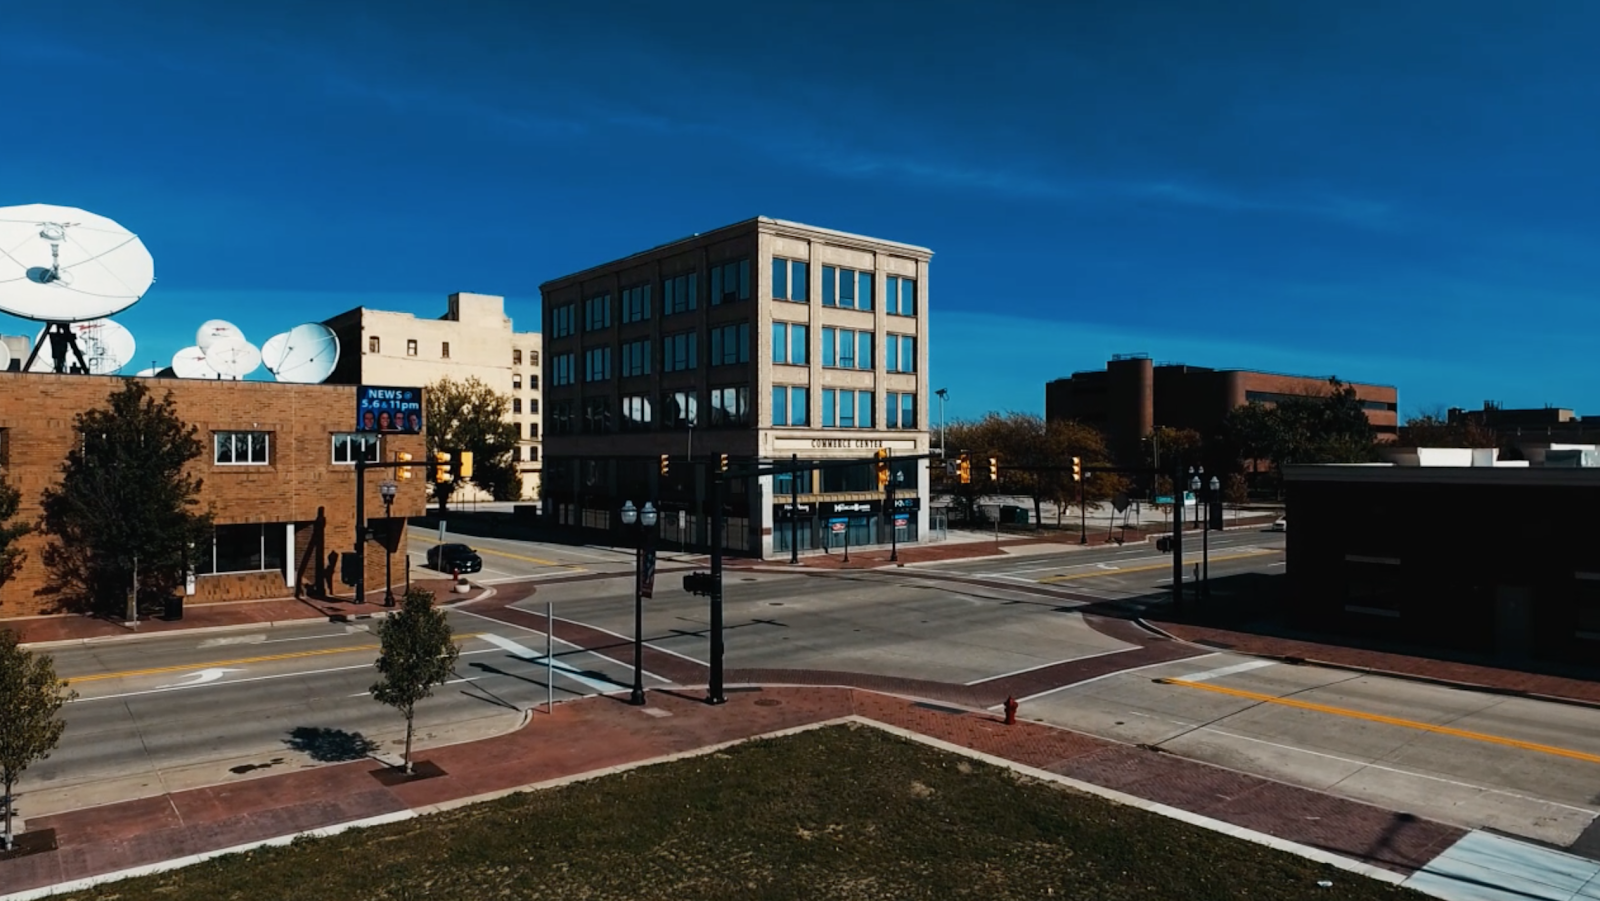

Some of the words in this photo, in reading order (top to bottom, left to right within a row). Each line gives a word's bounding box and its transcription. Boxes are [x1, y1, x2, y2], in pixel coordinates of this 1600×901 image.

[368, 389, 402, 399] NEWS
[811, 439, 850, 448] COMMERCE
[856, 440, 882, 448] CENTER
